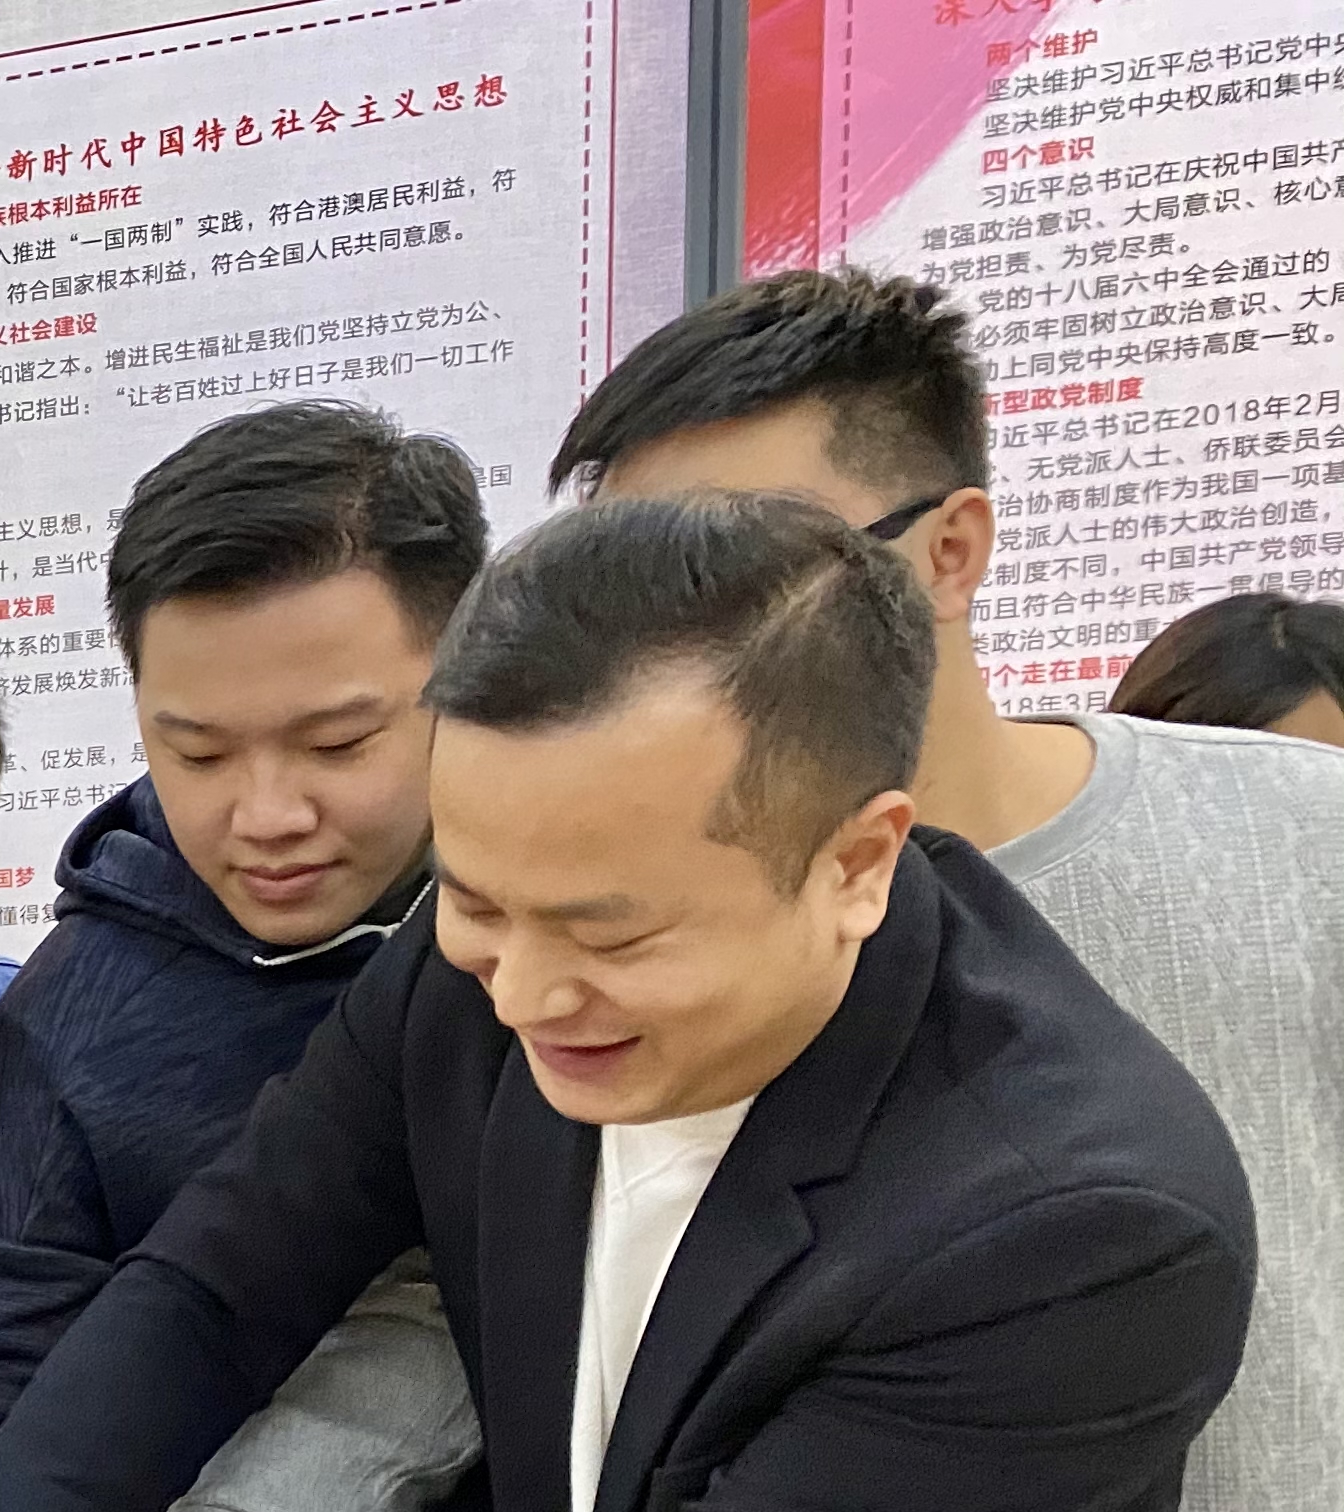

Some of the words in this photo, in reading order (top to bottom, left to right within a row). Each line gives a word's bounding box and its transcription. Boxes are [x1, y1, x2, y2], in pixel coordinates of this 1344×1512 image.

[985, 27, 1098, 68] 两个维护
[982, 134, 1095, 176] 四个意识
[921, 228, 1192, 288] 为党担责、为党尽责。
[978, 246, 1329, 316] 党的十八届六中全会通过的
[994, 458, 1344, 522] 治协商制度作为我国一项基
